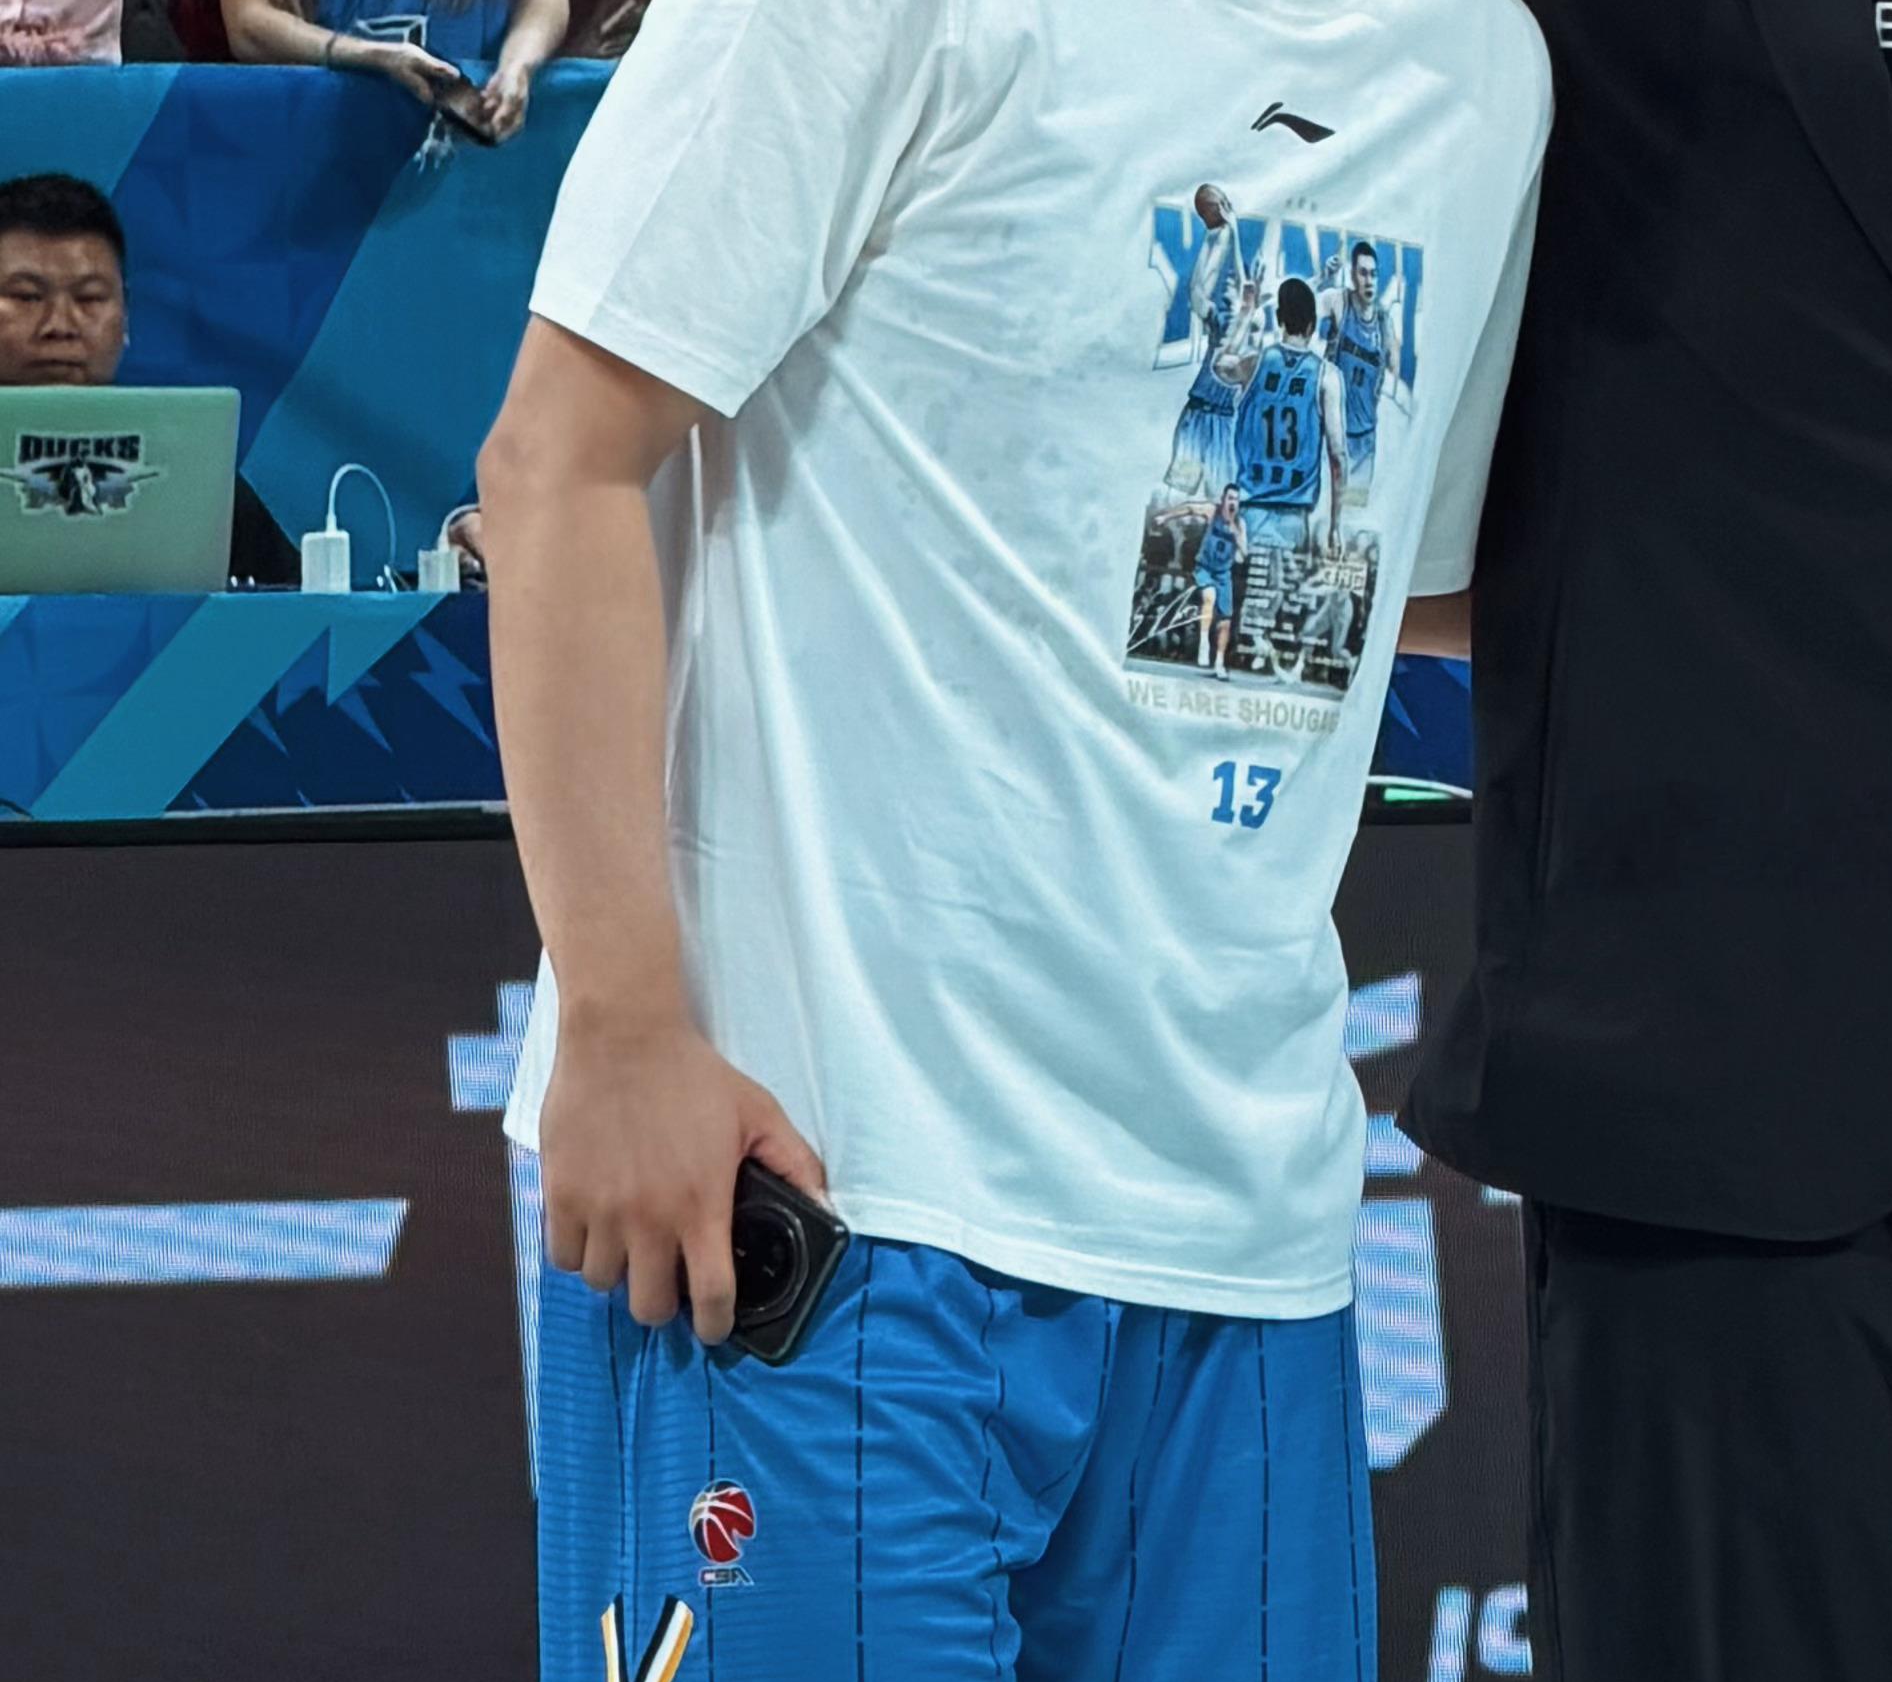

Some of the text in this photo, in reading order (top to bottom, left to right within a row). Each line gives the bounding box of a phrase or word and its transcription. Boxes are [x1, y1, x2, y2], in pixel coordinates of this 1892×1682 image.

[18, 433, 142, 465] DUCKS
[1262, 404, 1298, 462] 13
[1126, 678, 1342, 736] WE ARE SHOUG
[1211, 760, 1283, 830] 13
